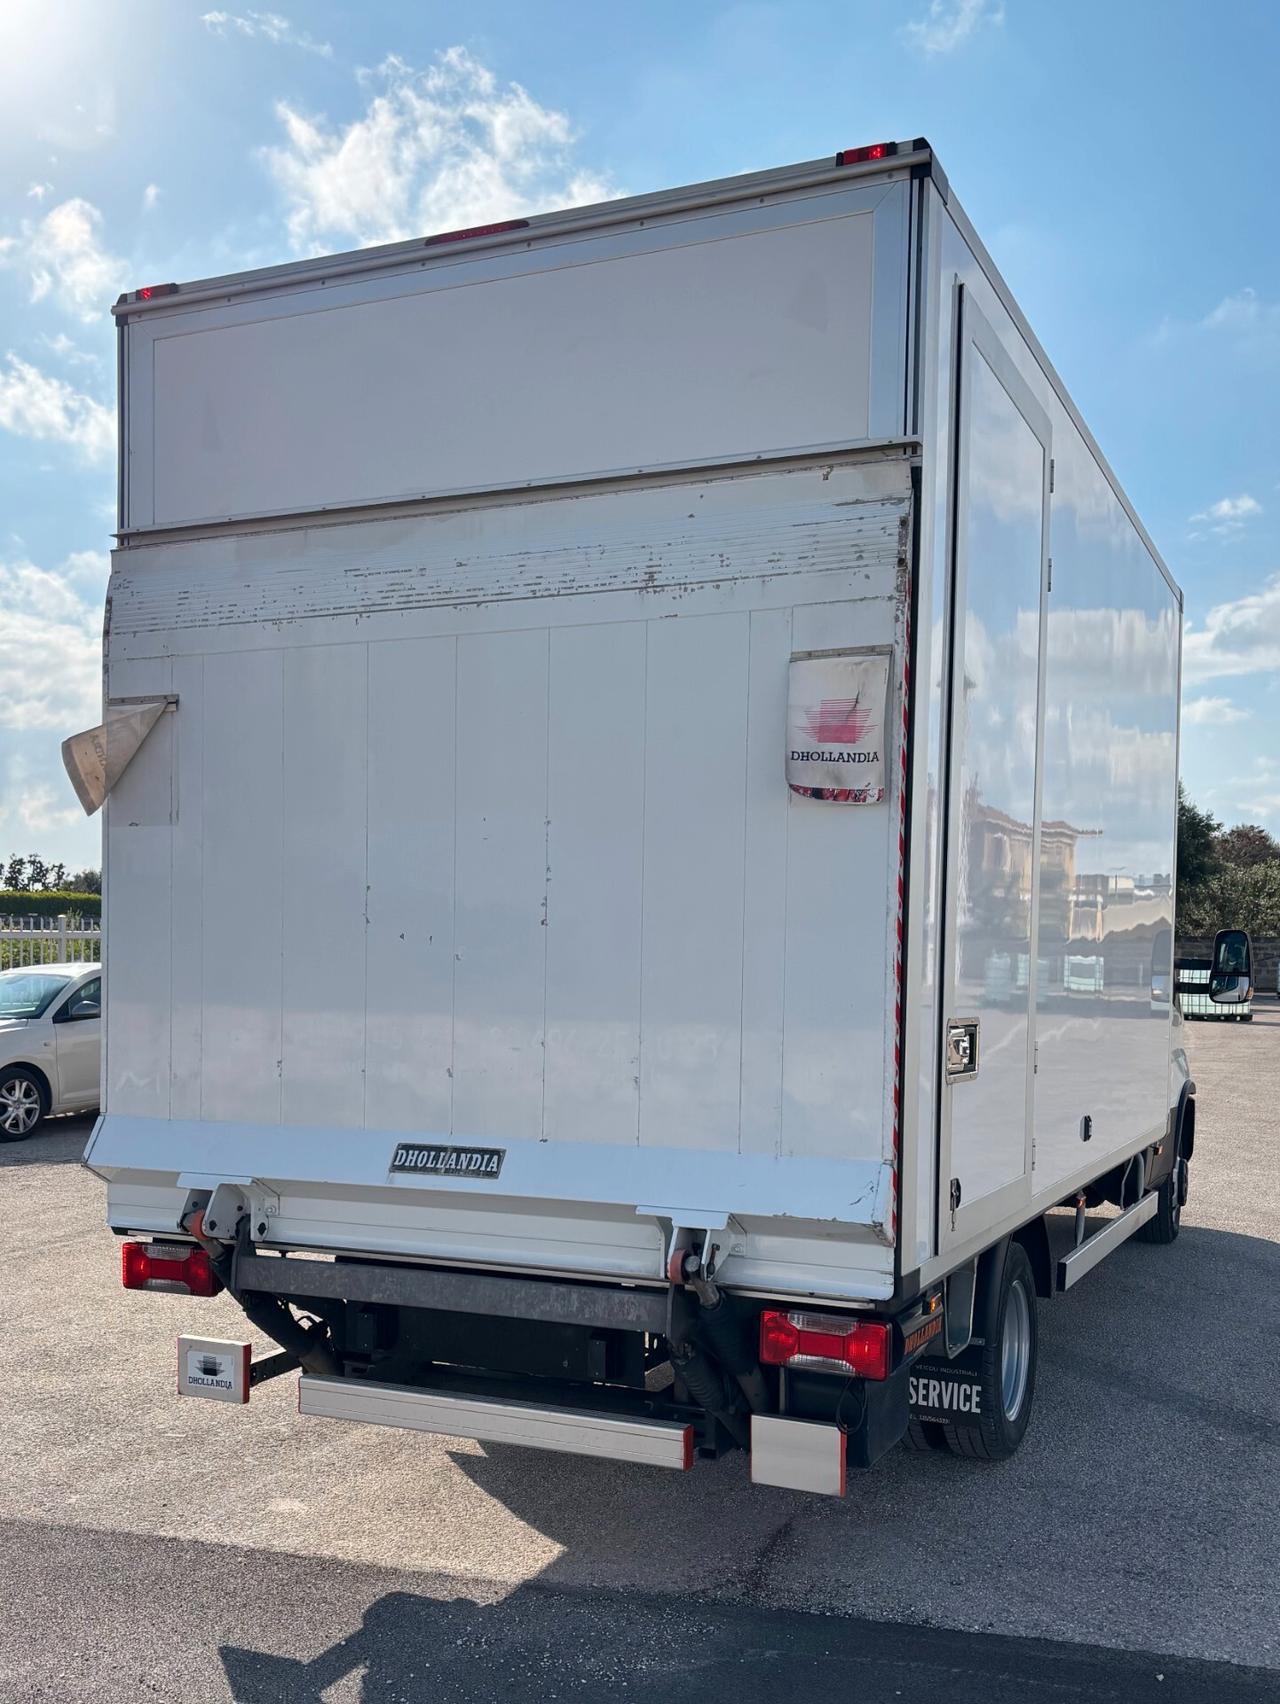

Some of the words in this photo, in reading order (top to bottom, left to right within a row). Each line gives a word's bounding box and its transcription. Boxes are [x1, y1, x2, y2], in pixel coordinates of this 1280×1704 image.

[791, 751, 879, 763] DHOLLANDIA
[394, 1149, 498, 1171] DHOLLANDIA
[188, 1376, 232, 1390] DHOLLANDIA
[909, 1376, 981, 1413] SERVICE
